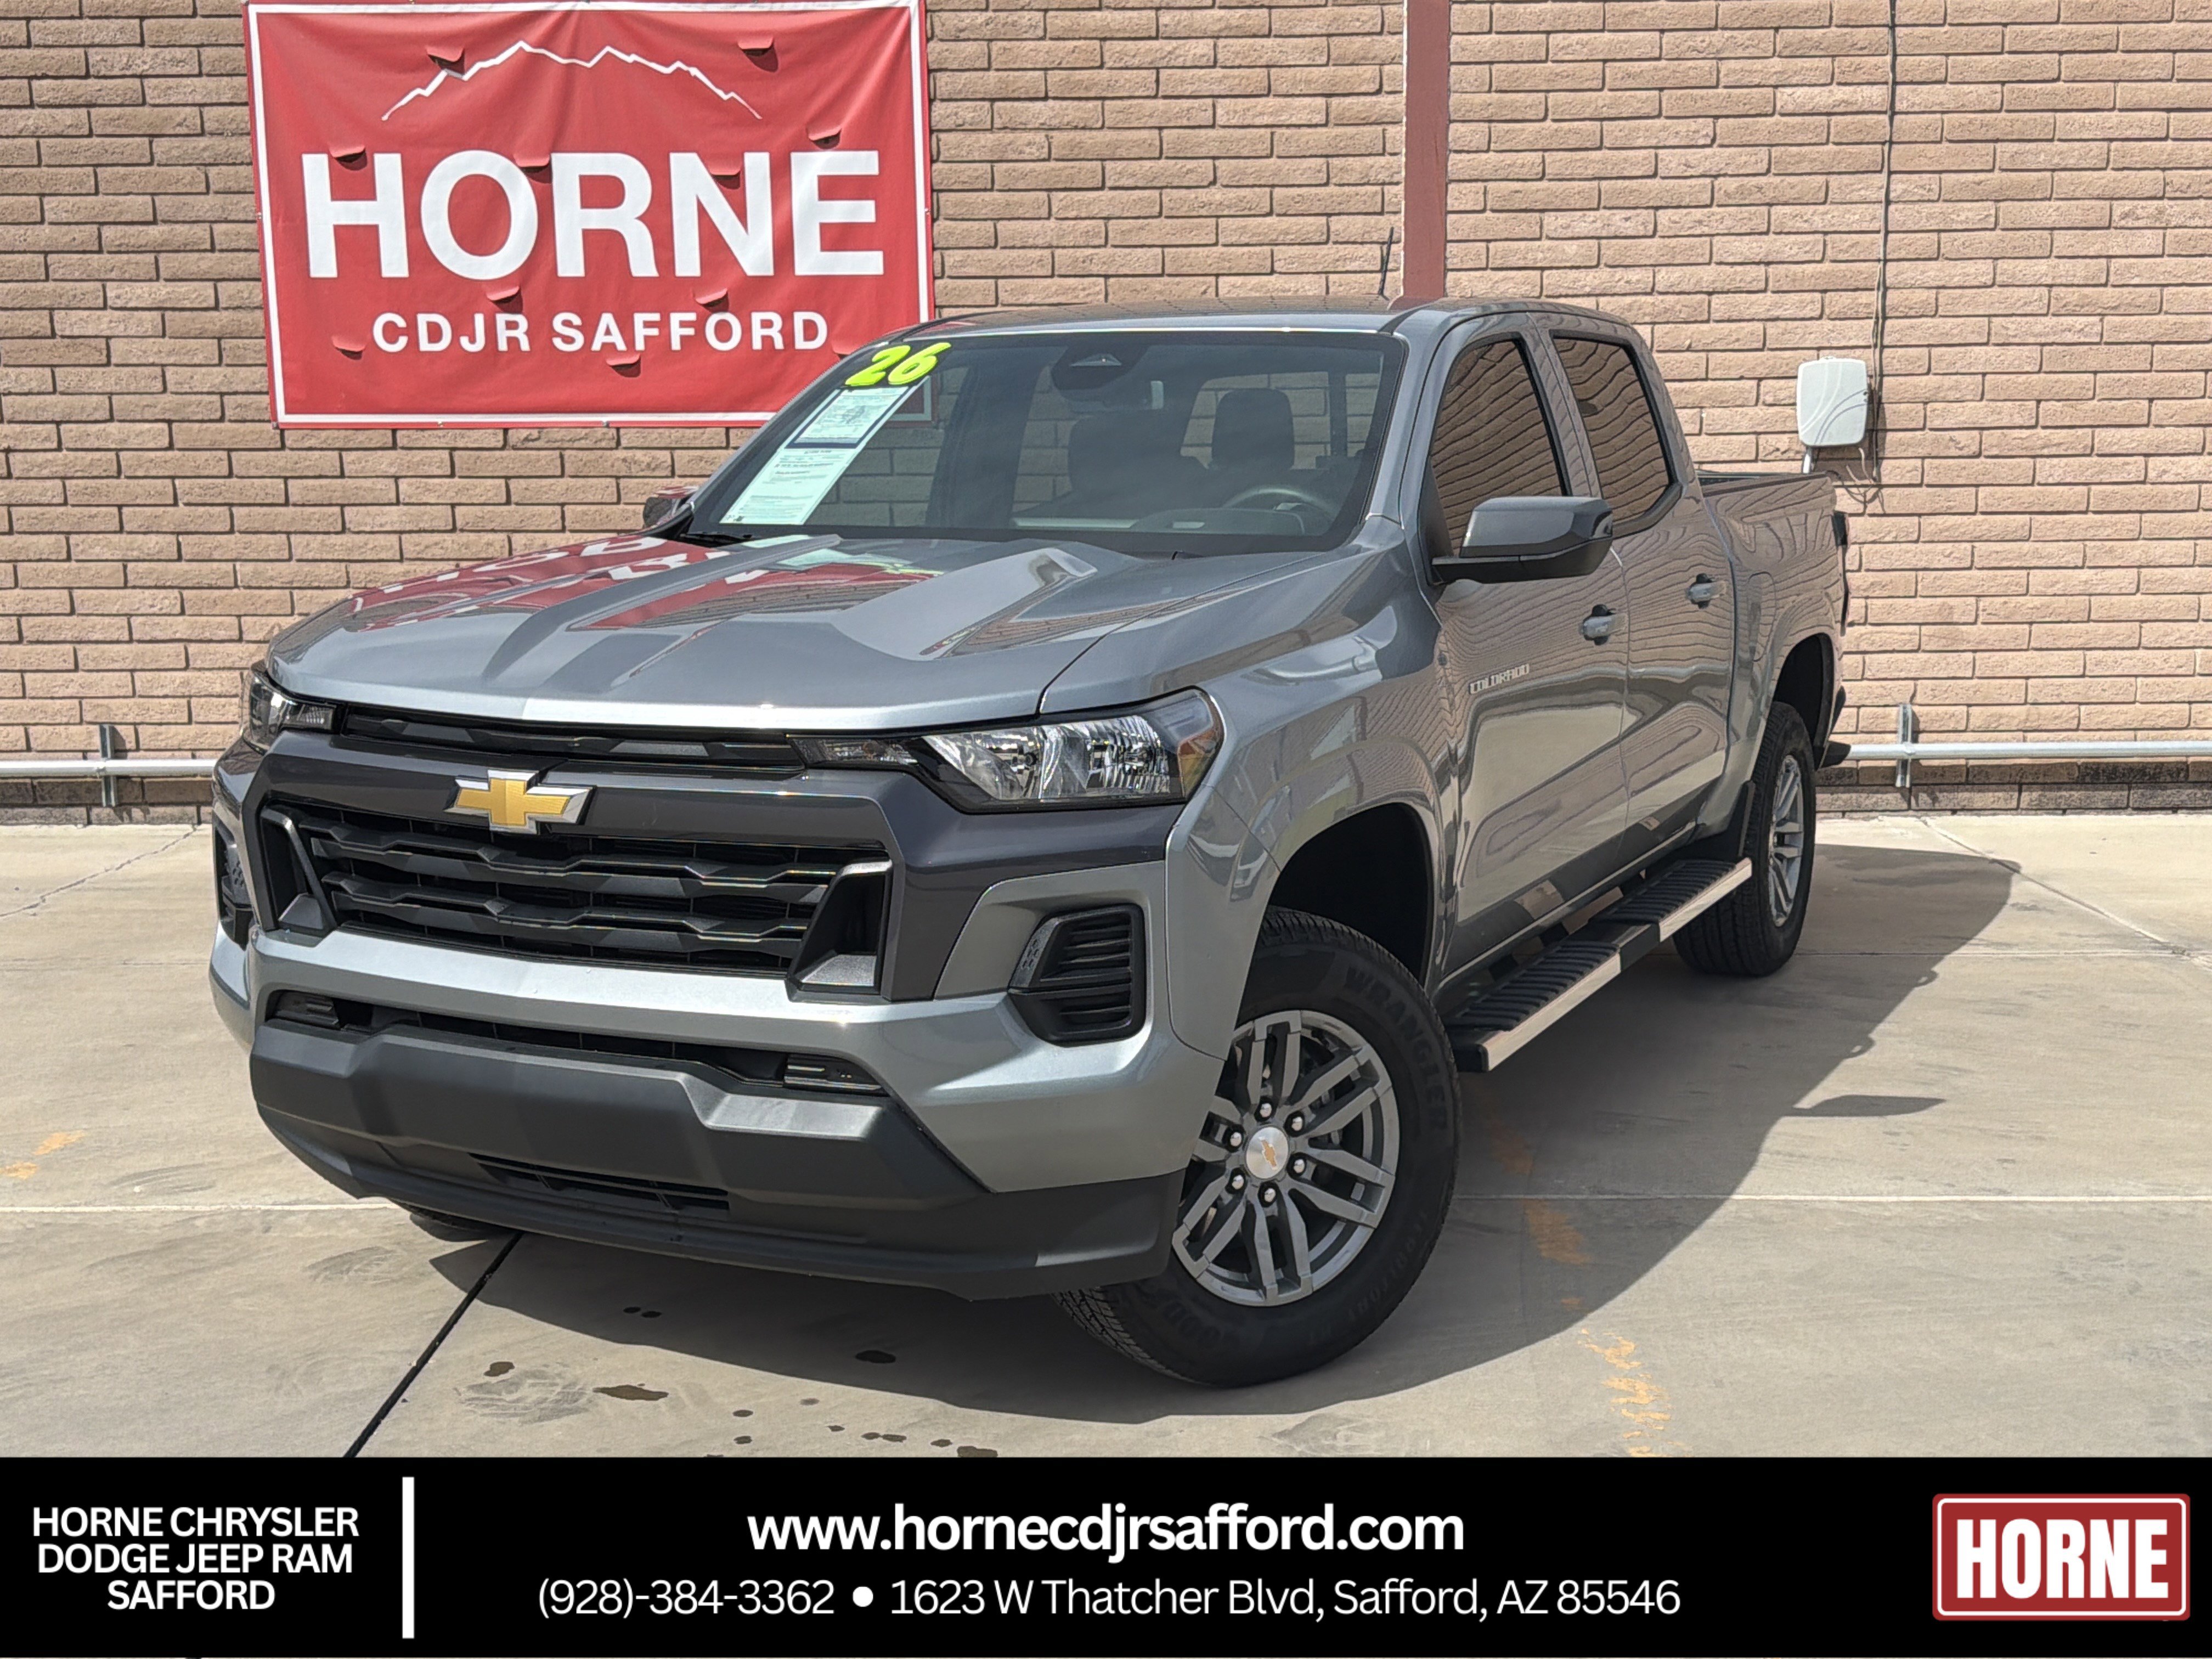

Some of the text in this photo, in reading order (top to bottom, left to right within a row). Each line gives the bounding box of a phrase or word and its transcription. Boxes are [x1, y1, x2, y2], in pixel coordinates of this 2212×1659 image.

[302, 150, 884, 280] HORNE
[373, 311, 828, 352] CDJR SAFFORD
[845, 342, 951, 386] 26
[1344, 964, 1448, 1130] WRANGLER
